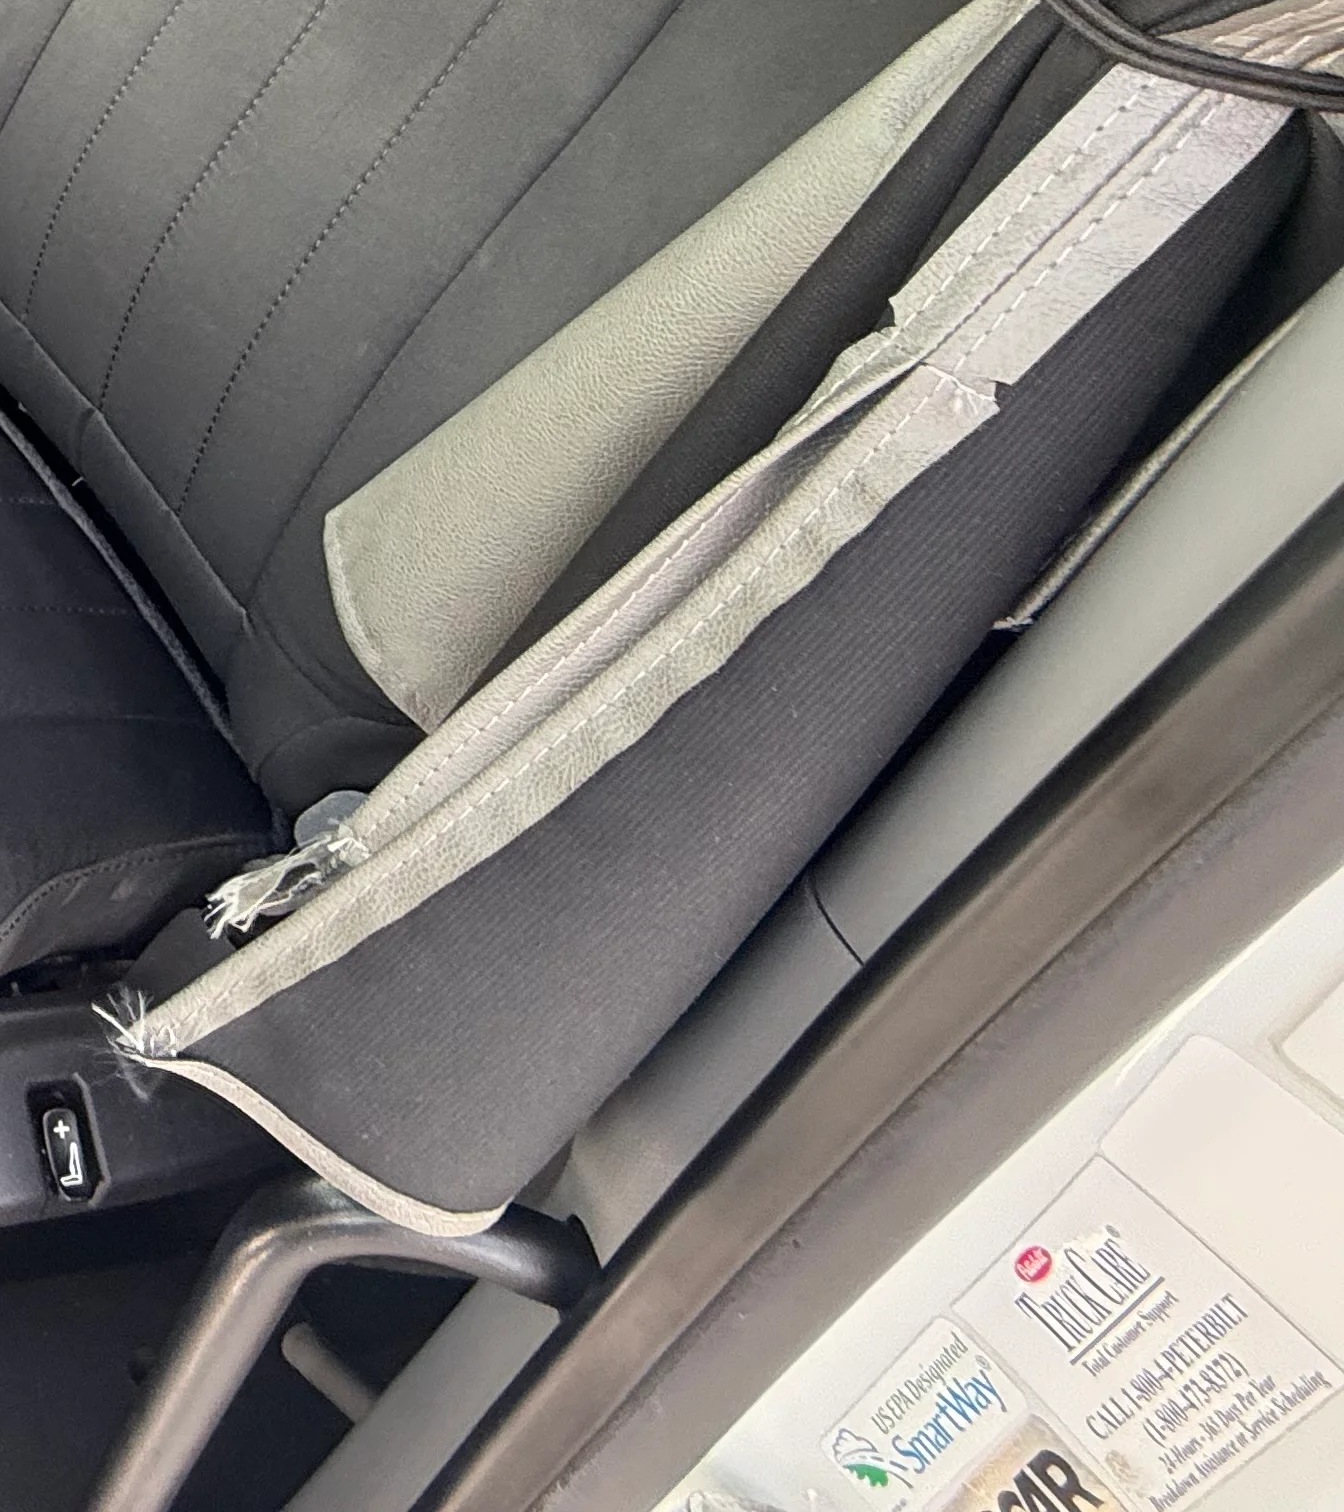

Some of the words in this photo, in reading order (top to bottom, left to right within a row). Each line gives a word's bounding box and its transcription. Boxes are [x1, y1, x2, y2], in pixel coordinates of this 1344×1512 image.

[1081, 1348, 1111, 1378] Total
[1101, 1320, 1147, 1360] Customer
[1136, 1290, 1180, 1327] Support
[870, 1405, 896, 1436] US
[885, 1388, 916, 1421] EPA
[903, 1329, 969, 1402] Designated
[1085, 1396, 1136, 1440] CALL
